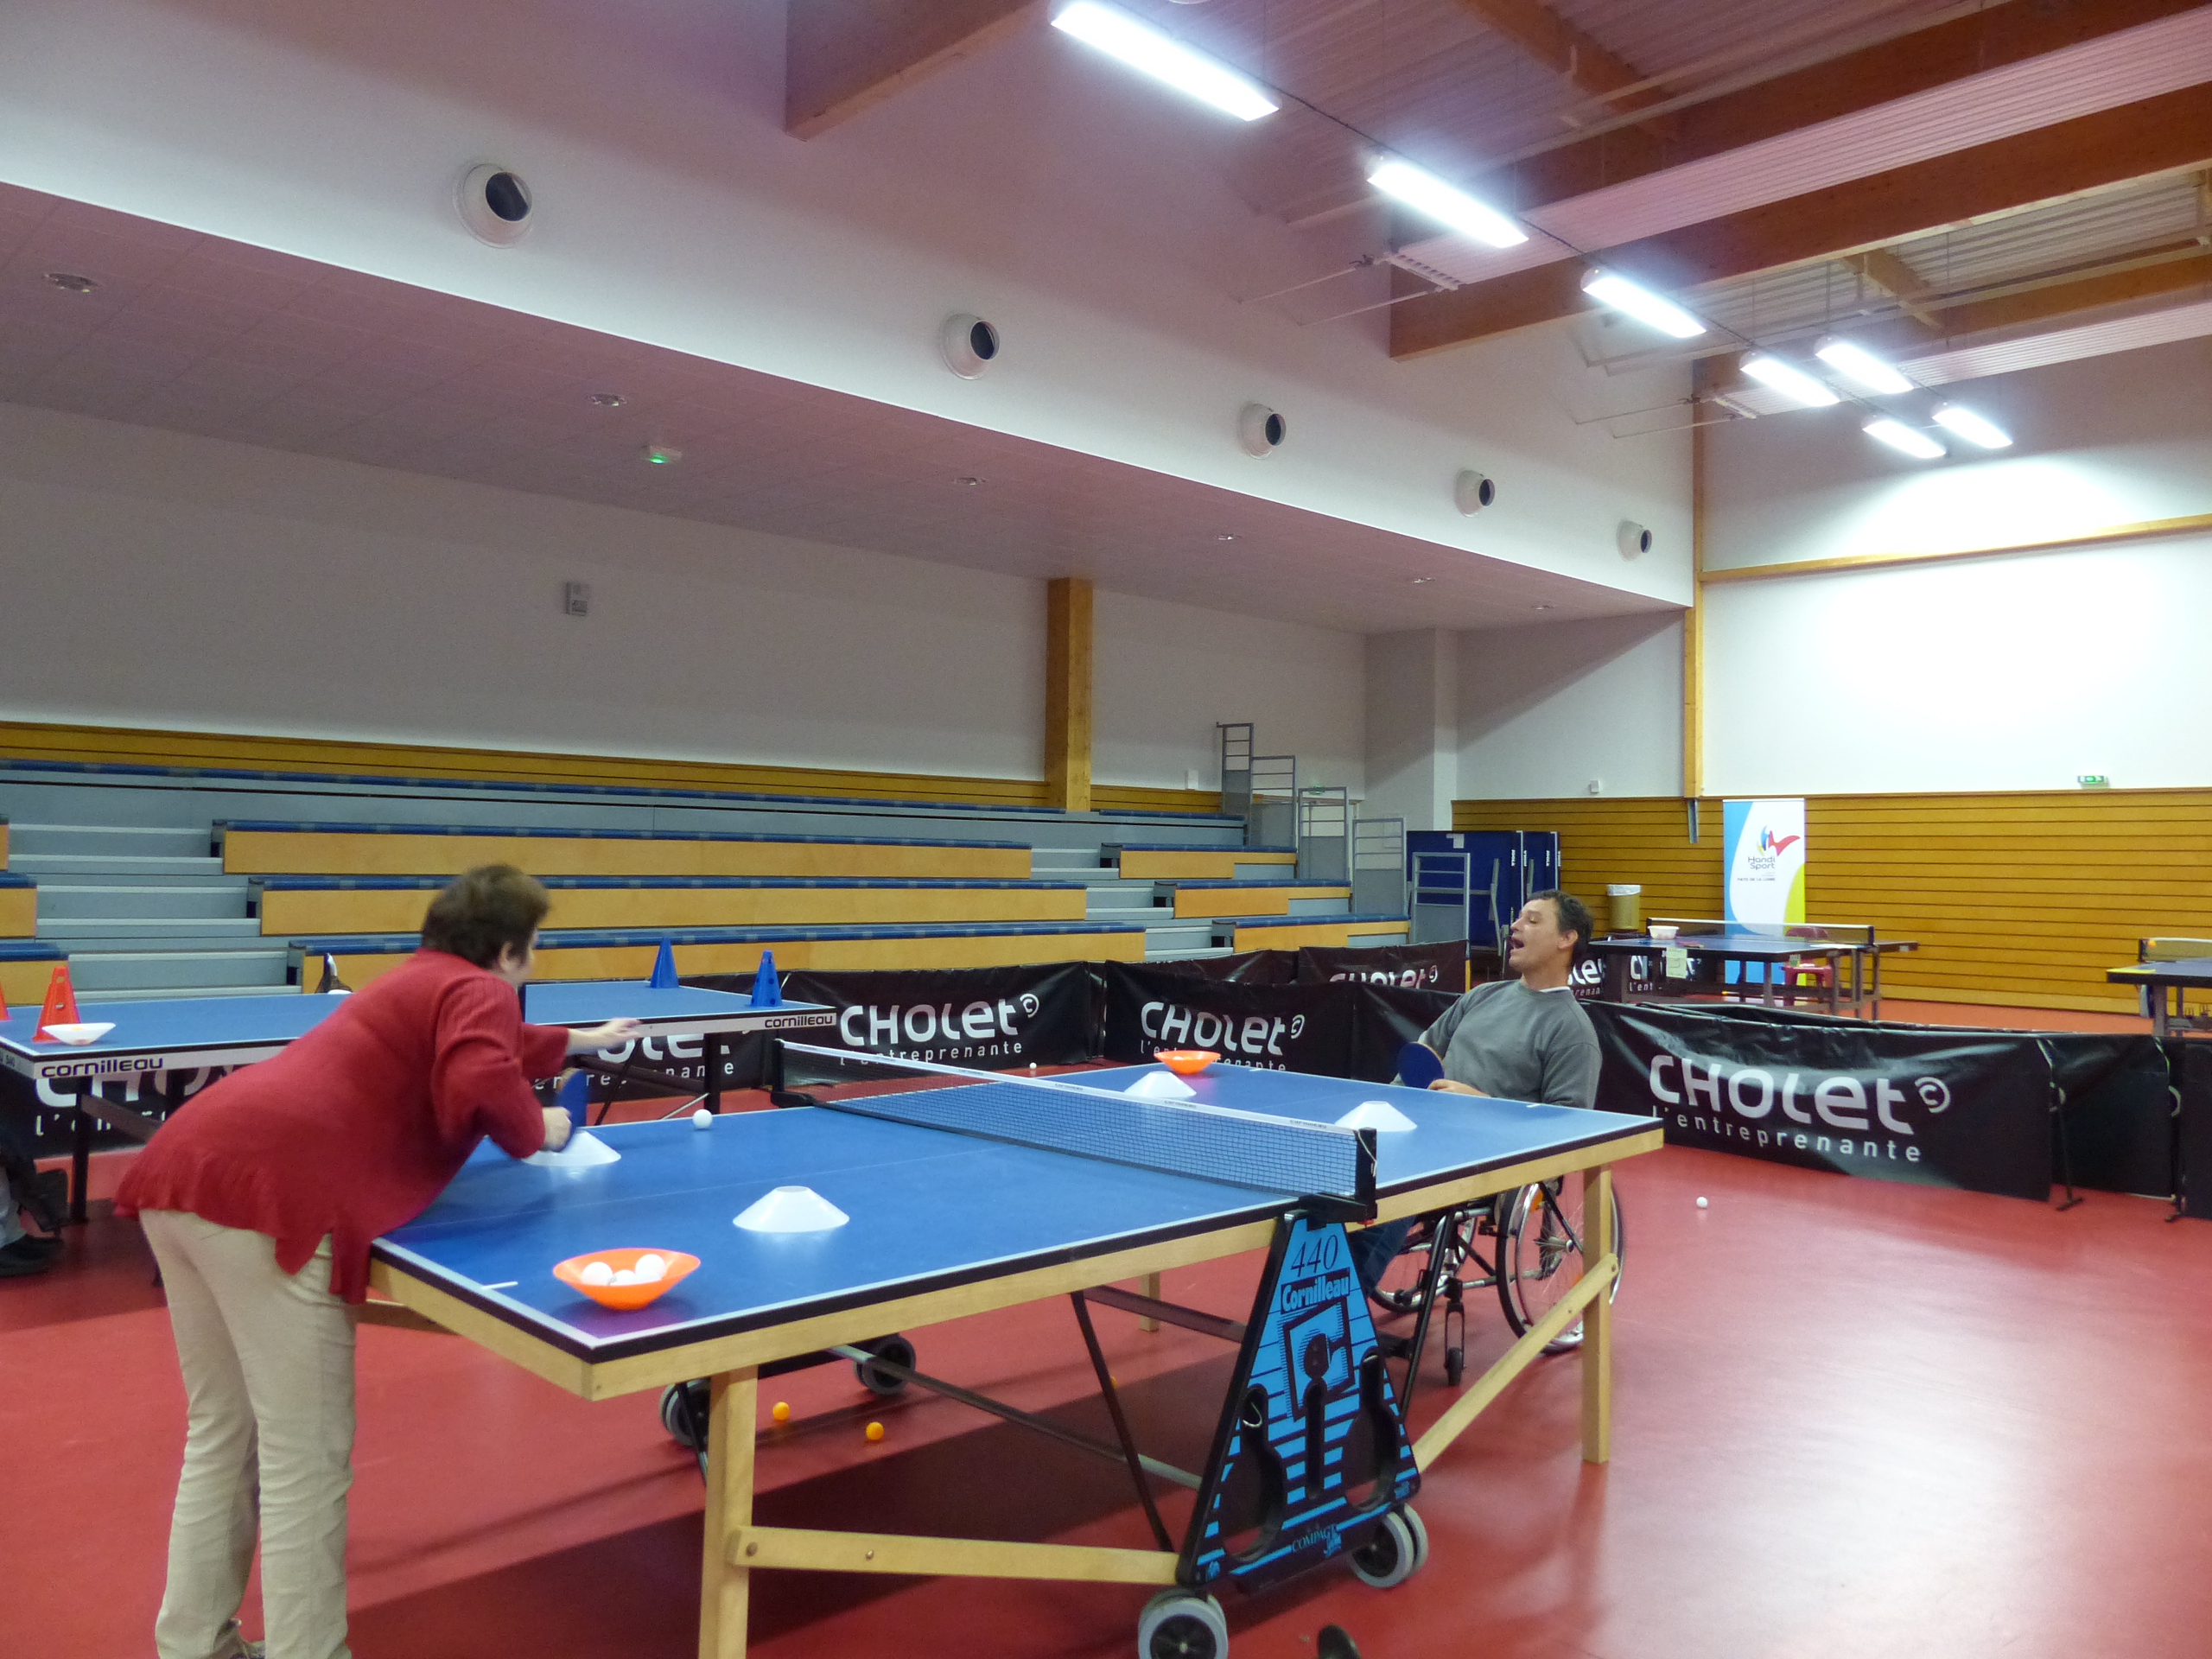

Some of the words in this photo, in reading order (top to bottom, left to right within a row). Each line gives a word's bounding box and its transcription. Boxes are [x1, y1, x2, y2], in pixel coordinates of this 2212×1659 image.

[765, 1014, 834, 1028] cornilleau
[41, 1058, 163, 1078] cornilleau
[1291, 1235, 1338, 1277] 440
[1281, 1275, 1349, 1312] Cornilleau
